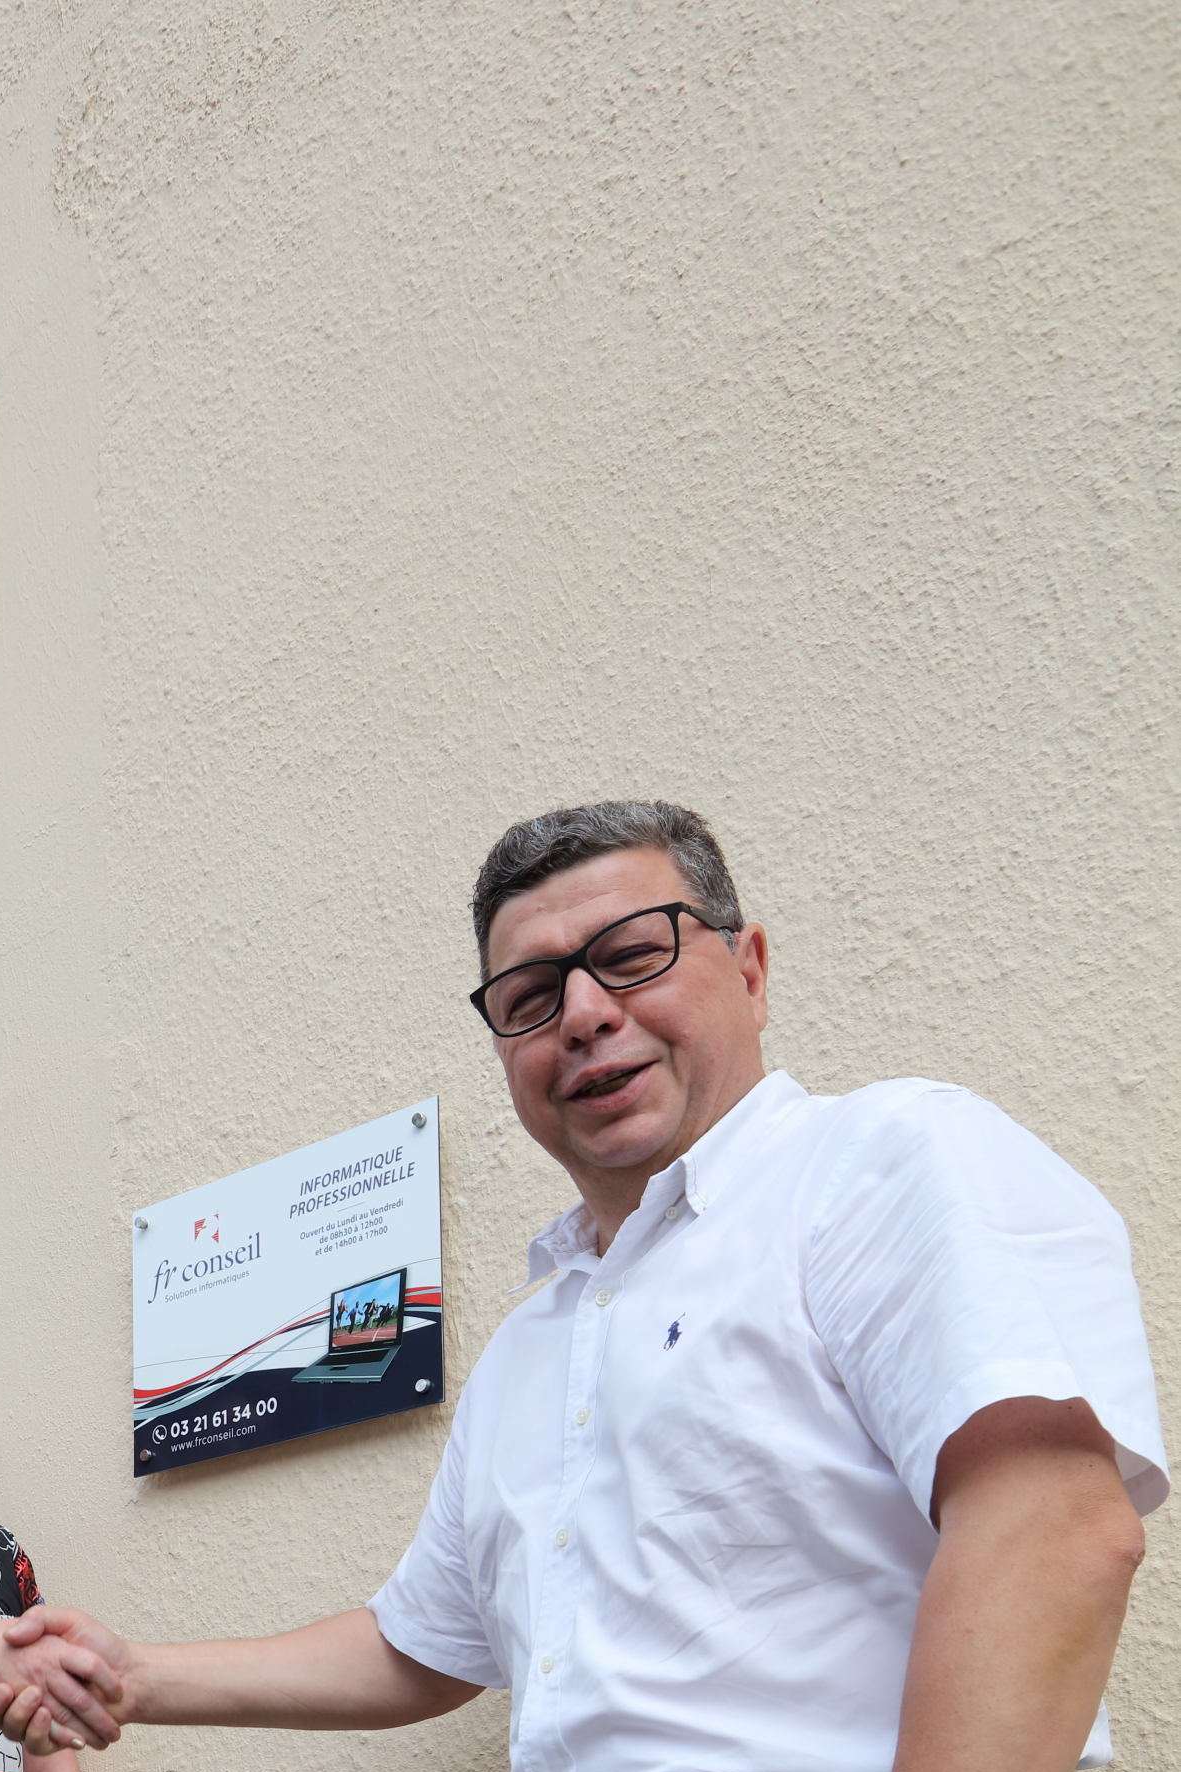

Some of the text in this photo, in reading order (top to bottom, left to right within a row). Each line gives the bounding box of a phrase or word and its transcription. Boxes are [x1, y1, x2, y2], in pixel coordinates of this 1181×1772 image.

[289, 1161, 416, 1219] PROFESSIONNELLE
[299, 1145, 403, 1196] INFORMATIQUE
[299, 1198, 404, 1240] Ouvert du Lundi au Vendredi
[319, 1216, 383, 1244] de 08h30 à 12h00
[314, 1225, 388, 1256] et de 14h00 à 17h00
[147, 1231, 262, 1304] fr conseil
[164, 1270, 250, 1303] Solutions informatiques
[170, 1397, 278, 1438] 03 21 61 34 00
[170, 1424, 257, 1453] www.frconseil.com
